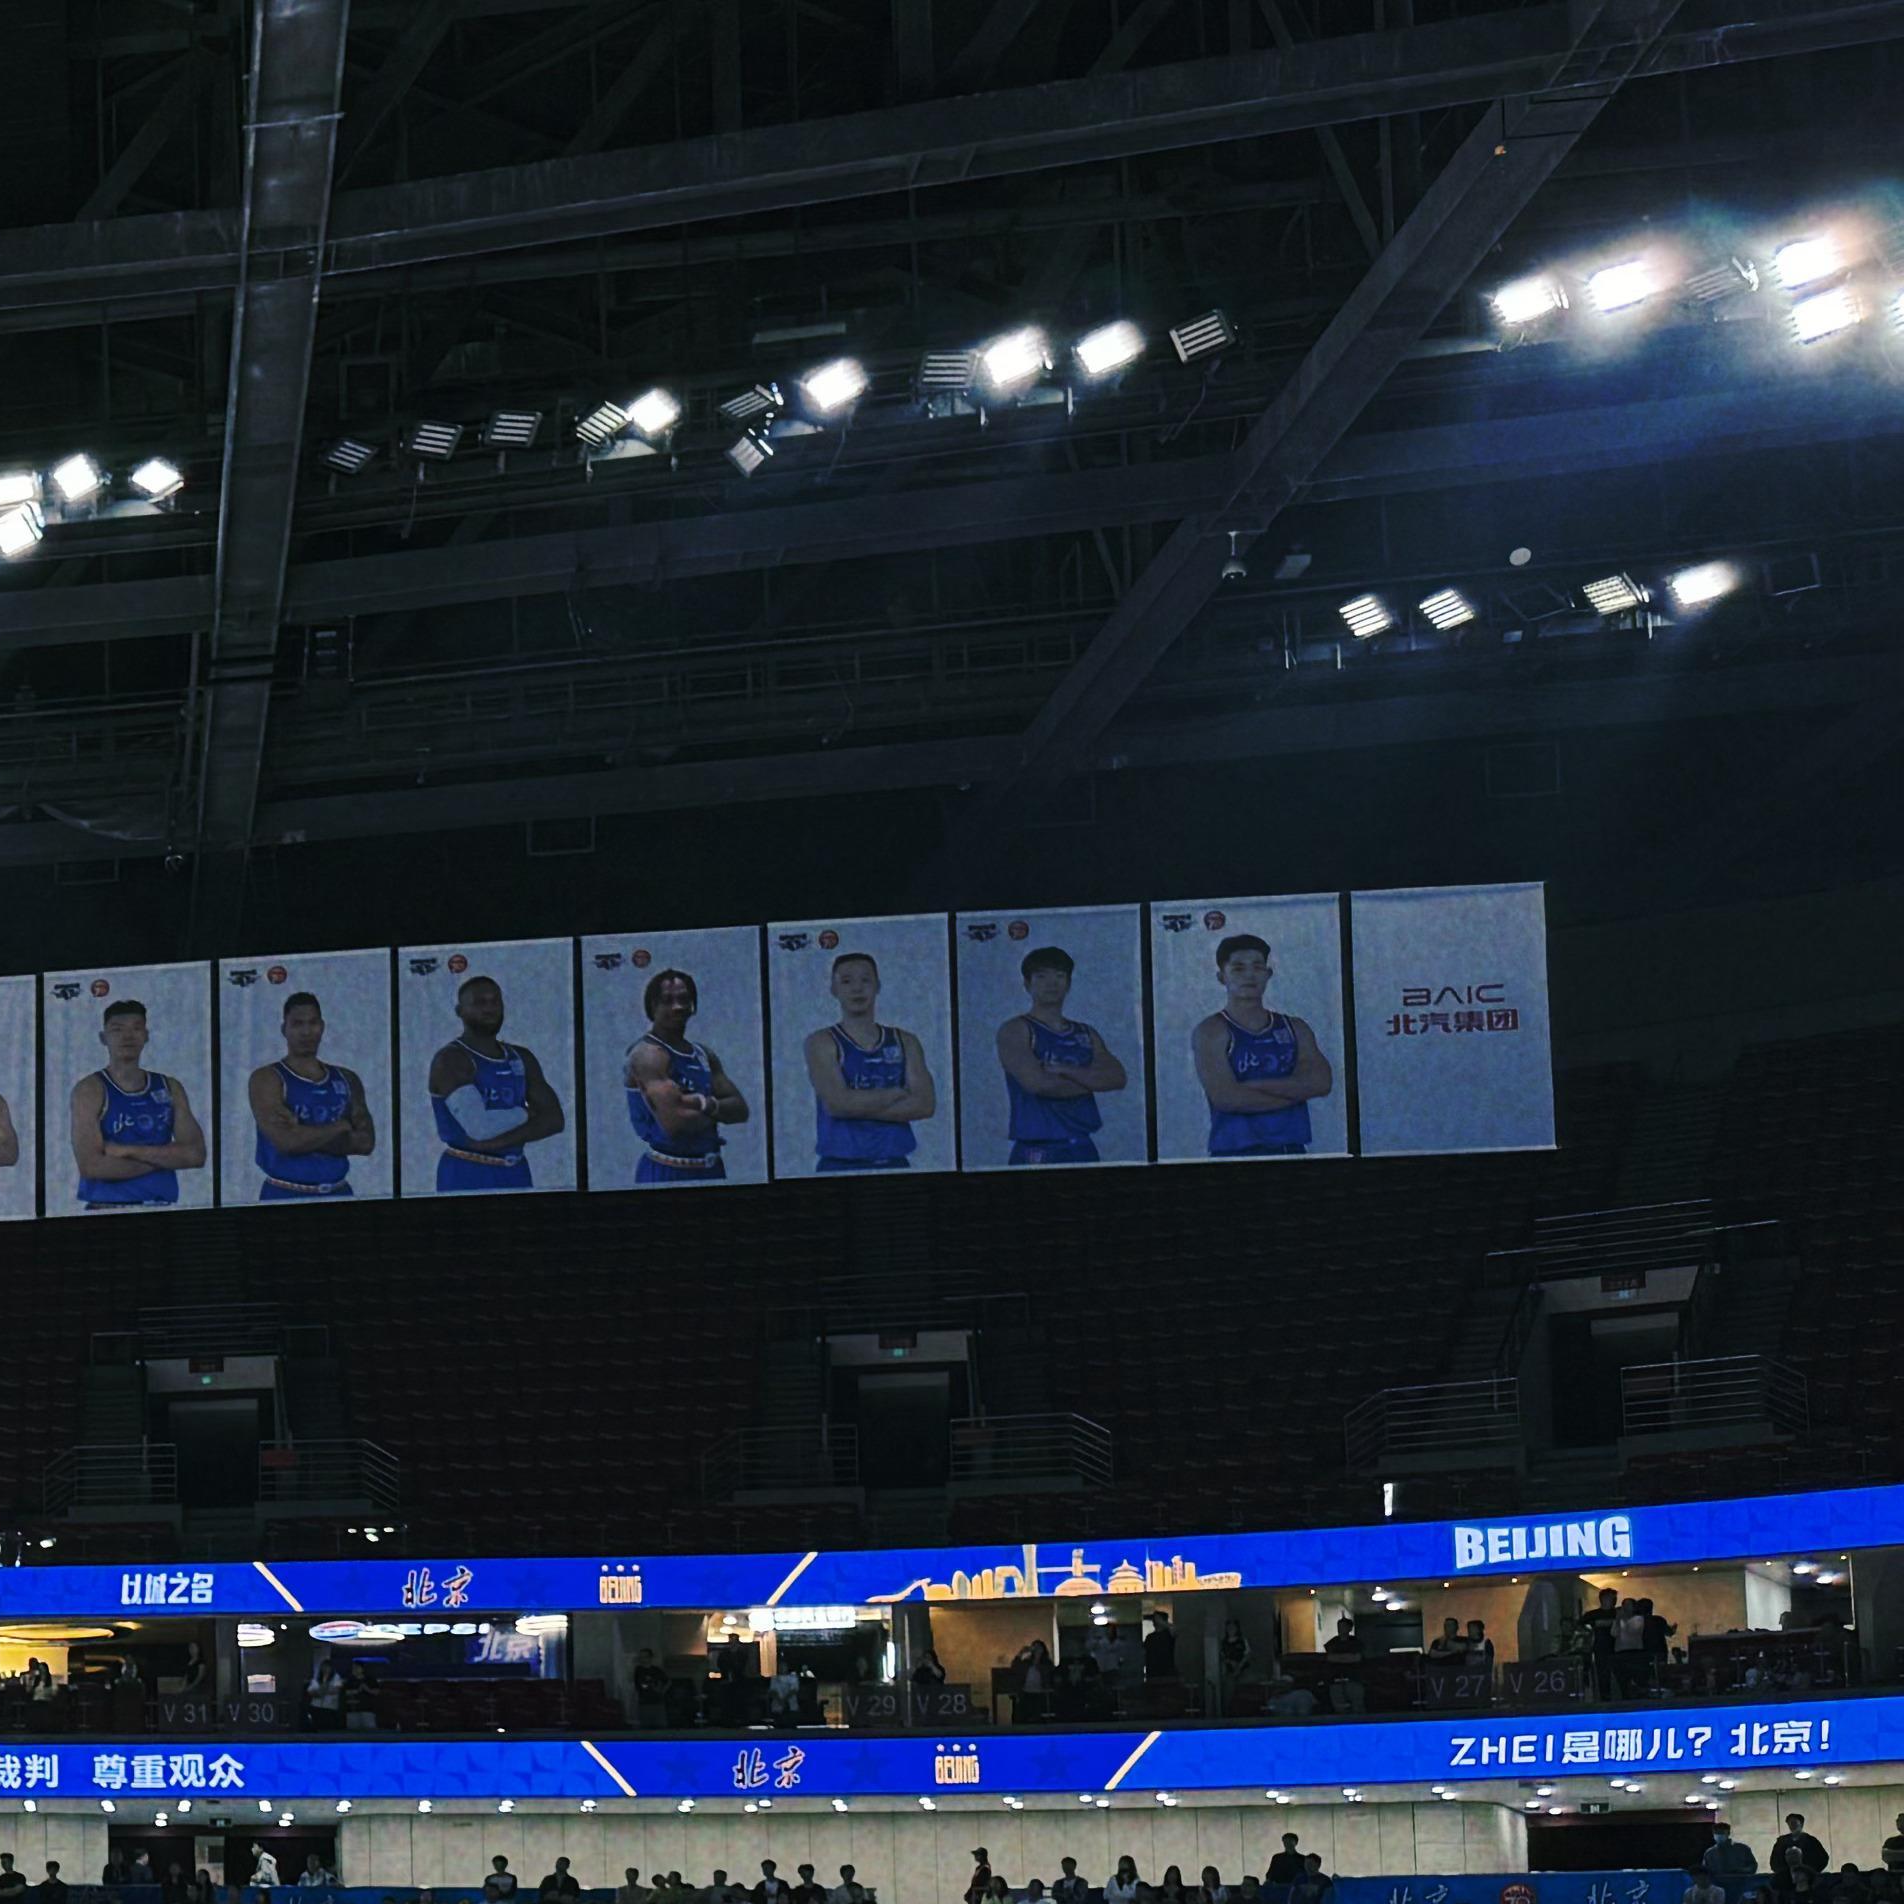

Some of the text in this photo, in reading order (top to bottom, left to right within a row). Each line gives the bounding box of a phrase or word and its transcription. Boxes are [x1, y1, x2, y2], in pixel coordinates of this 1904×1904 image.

[1402, 984, 1505, 1006] BAIC
[1386, 1008, 1519, 1037] 北汽集团
[1454, 1515, 1633, 1569] BEIJING
[121, 1573, 214, 1605] 以城之名
[402, 1565, 474, 1608] 北京
[599, 1573, 642, 1604] BEIJING
[1431, 1674, 1484, 1698] V 27
[1510, 1669, 1566, 1694] V 26
[165, 1703, 206, 1724] V 31
[228, 1702, 273, 1724] V 30
[847, 1692, 896, 1715] V 29
[918, 1692, 967, 1715] V 28
[1730, 1719, 1831, 1757] 北京!
[92, 1752, 245, 1790] 尊重观众
[733, 1746, 805, 1790] 北京
[935, 1753, 979, 1785] BEIJING
